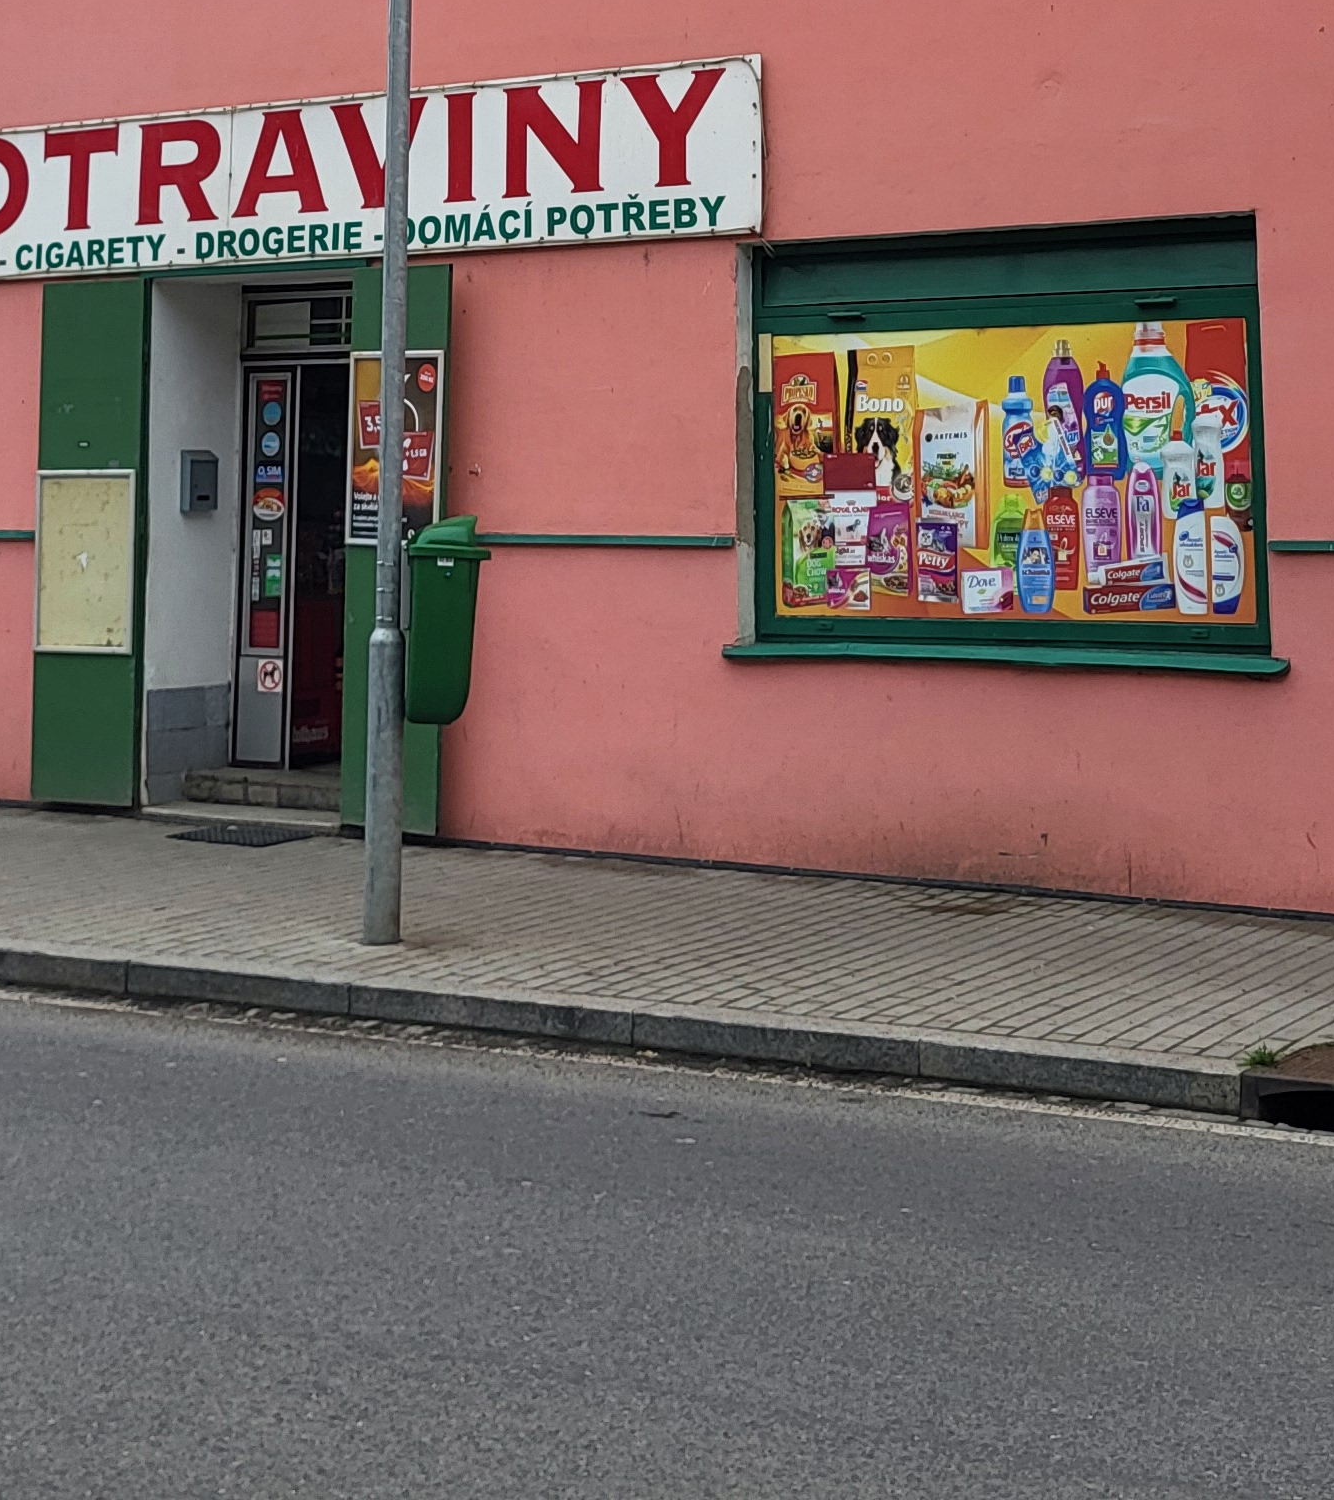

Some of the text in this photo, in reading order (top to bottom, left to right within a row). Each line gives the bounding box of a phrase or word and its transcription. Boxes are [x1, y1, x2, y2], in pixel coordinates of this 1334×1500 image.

[15, 234, 166, 271] CIGARETY
[196, 221, 363, 259] DROGERIE
[547, 193, 727, 237] POTŘEBY
[857, 394, 904, 412] Bono
[1093, 396, 1114, 415] pur
[1125, 390, 1172, 411] Persil
[934, 431, 968, 440] ARTEMIS
[1171, 483, 1192, 500] Jar
[1107, 568, 1141, 580] Colgate
[1090, 592, 1141, 607] Colgate
